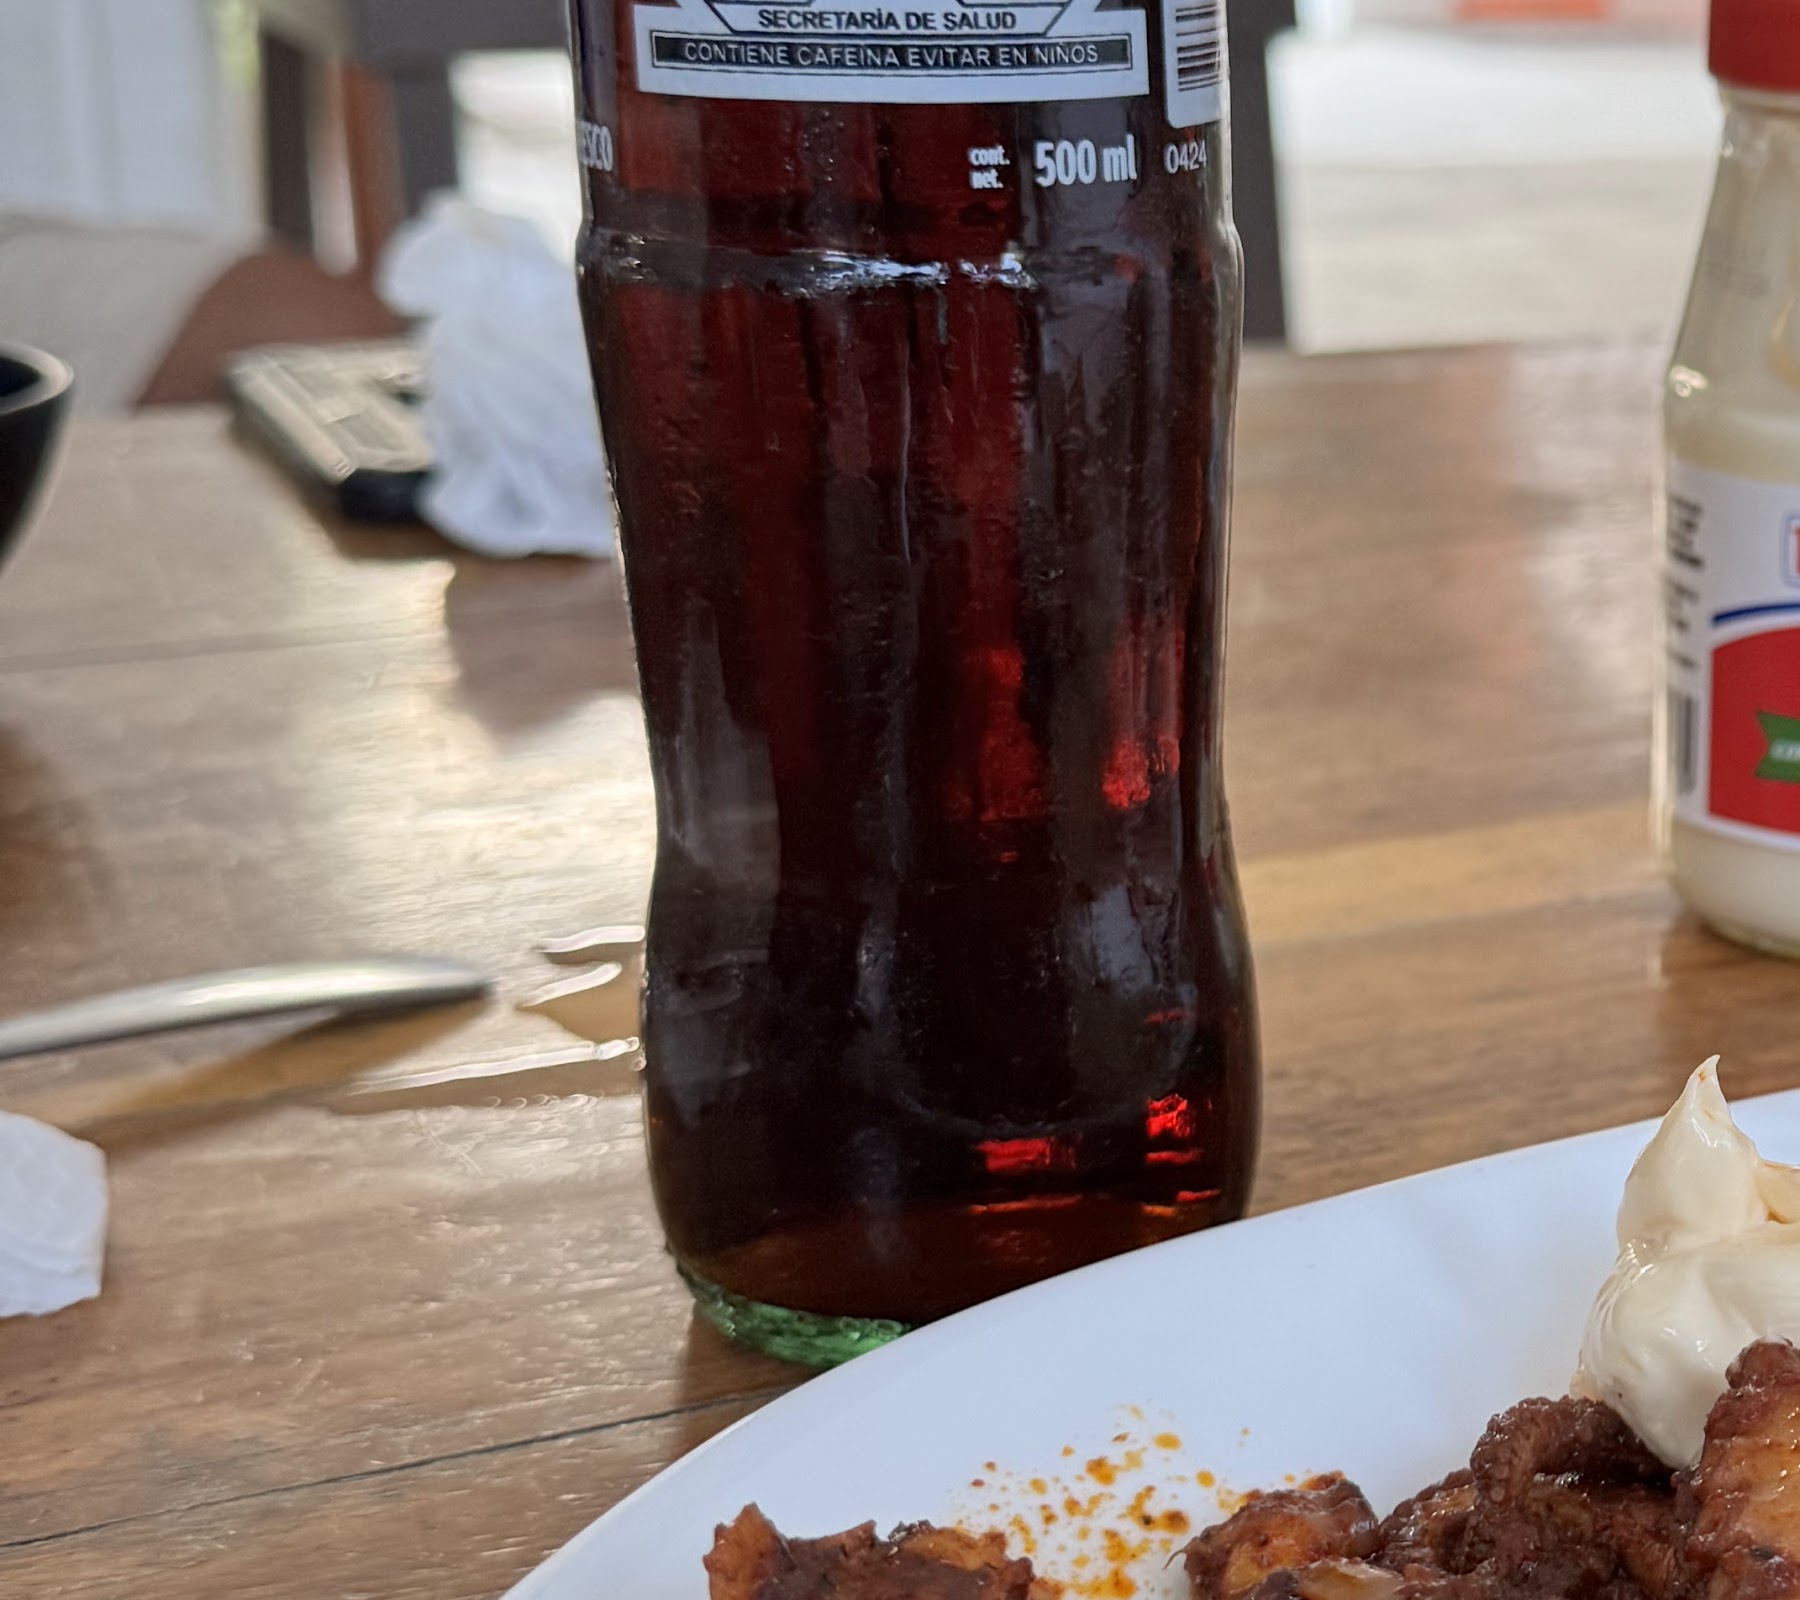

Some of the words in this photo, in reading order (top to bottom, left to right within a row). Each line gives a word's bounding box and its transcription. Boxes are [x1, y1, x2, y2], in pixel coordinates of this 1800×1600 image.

[757, 6, 901, 32] SECRETARÍA
[904, 8, 937, 32] DE
[942, 11, 1018, 32] SALUD
[683, 41, 789, 66] CONTIENE
[907, 47, 992, 68] EVITAR
[998, 45, 1028, 67] EN
[1034, 40, 1100, 65] NIÑOS
[970, 145, 1011, 166] cont.
[1034, 138, 1097, 187] 500
[1102, 133, 1137, 183] ml
[969, 168, 1005, 190] net.
